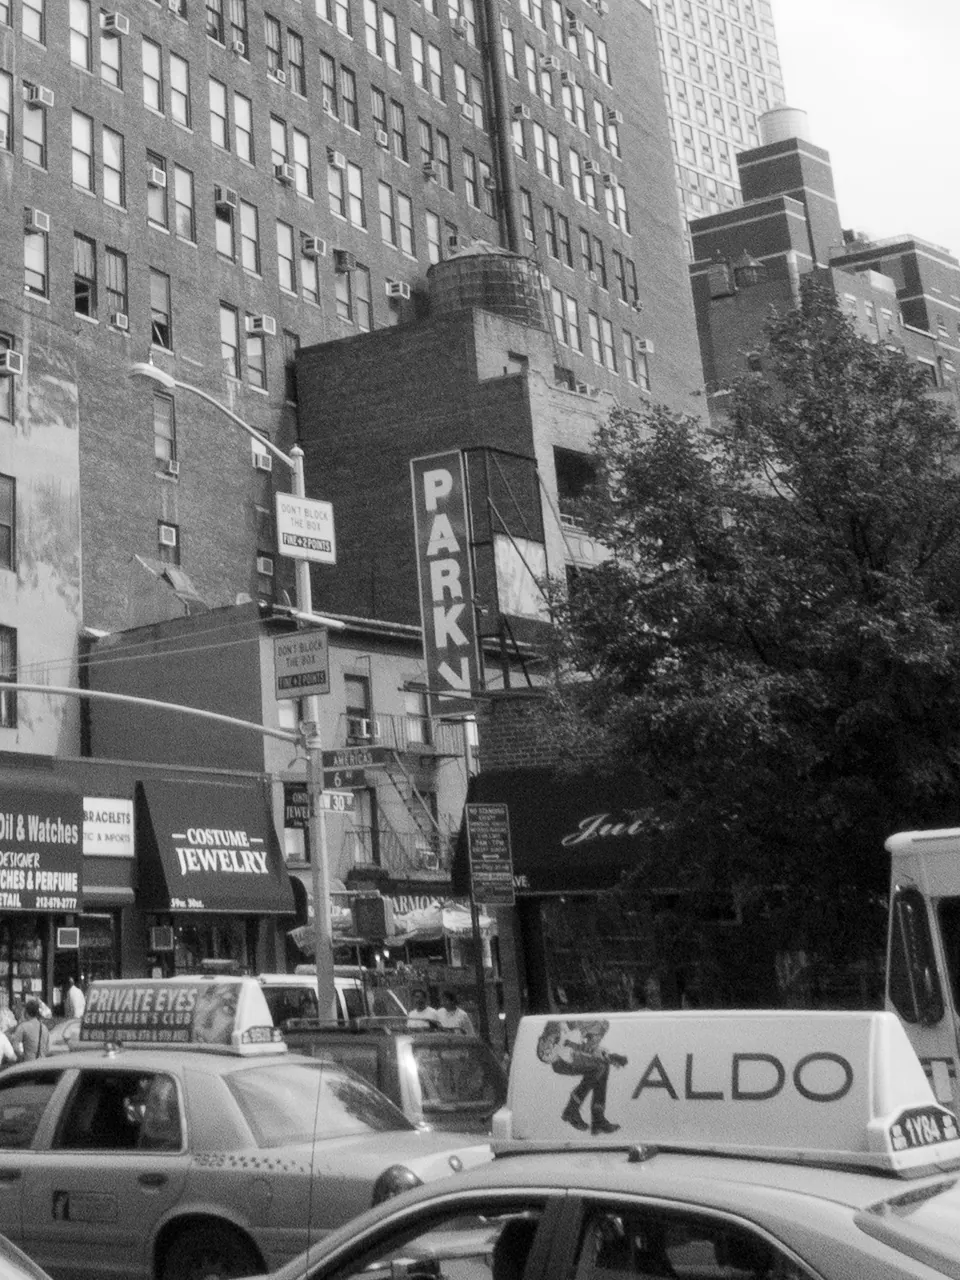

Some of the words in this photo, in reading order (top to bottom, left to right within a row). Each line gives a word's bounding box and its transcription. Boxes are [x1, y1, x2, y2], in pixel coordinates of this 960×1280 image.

[281, 503, 301, 515] DON'T
[304, 508, 329, 521] BLOCK
[290, 517, 304, 529] THE
[306, 520, 321, 532] BOX
[307, 538, 331, 552] POINTS
[423, 468, 470, 648] PARK
[299, 639, 324, 653] BLOCK
[334, 772, 341, 787] 6
[333, 795, 345, 811] 30
[83, 810, 131, 825] BRACELETS
[16, 813, 26, 841] &
[28, 815, 79, 844] Watches
[186, 827, 250, 848] COSTUME
[175, 847, 269, 875] JEWELRY
[26, 869, 34, 890] &
[35, 871, 78, 892] PERFUME
[88, 988, 155, 1012] PRIVATE
[155, 988, 198, 1012] EYES
[163, 1011, 191, 1025] CLUB
[631, 1052, 855, 1103] ALDO
